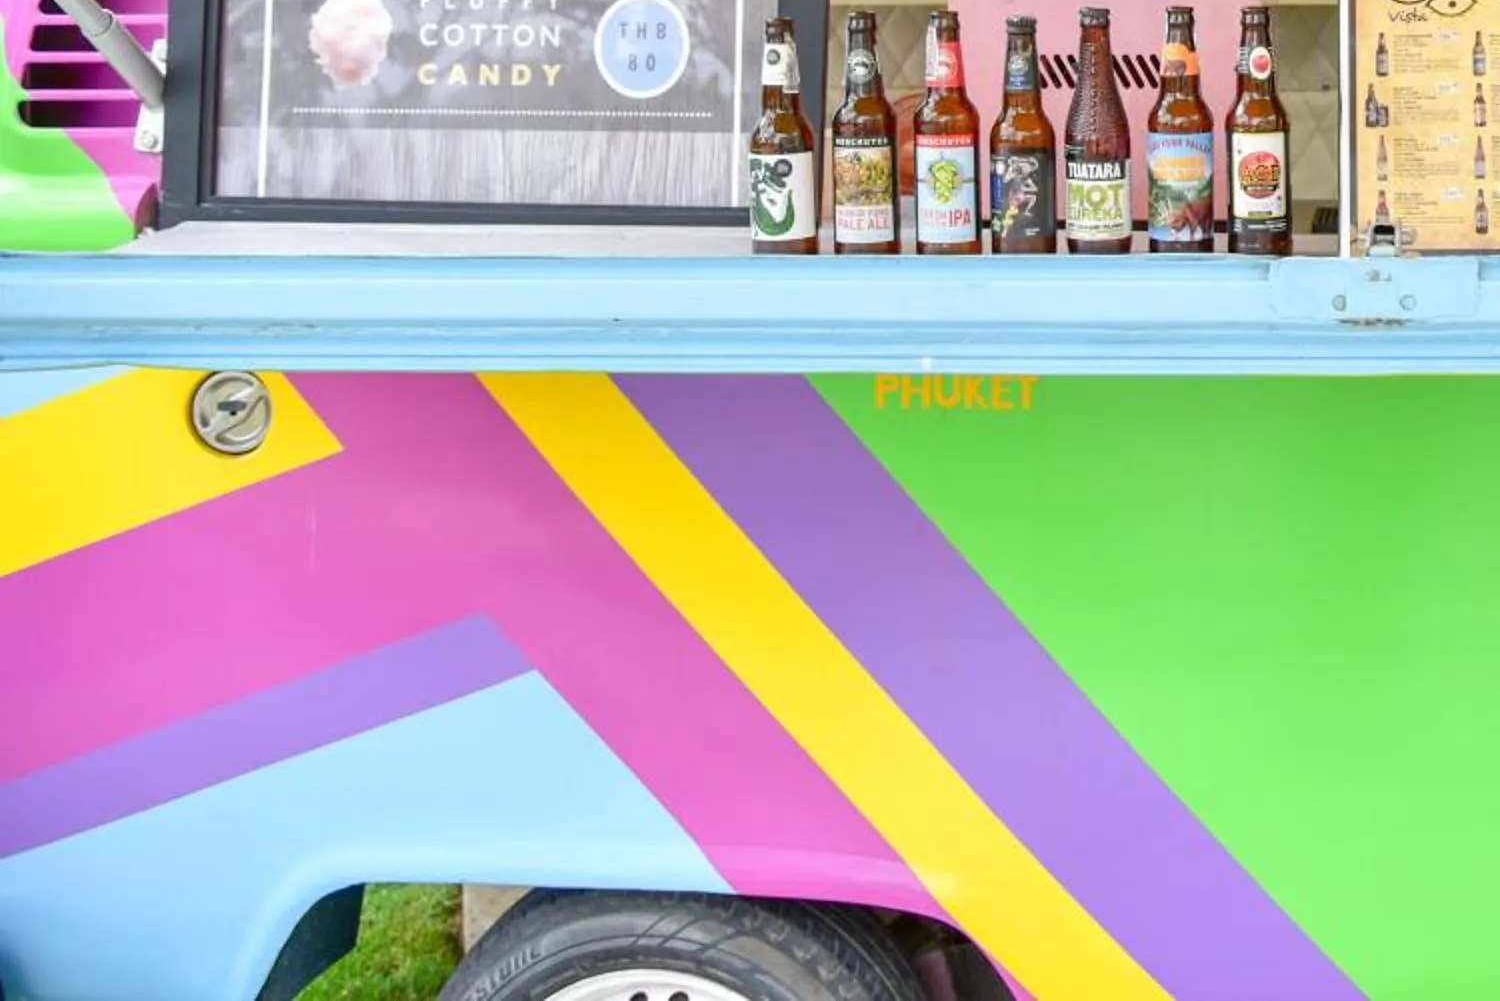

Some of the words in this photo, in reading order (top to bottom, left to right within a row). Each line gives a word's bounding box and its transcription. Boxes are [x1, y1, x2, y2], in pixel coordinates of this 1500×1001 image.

[419, 24, 560, 46] COTTON
[618, 22, 666, 39] THB
[628, 54, 656, 72] 80
[418, 64, 560, 86] CANDY
[1068, 162, 1121, 179] TUATARA
[949, 208, 970, 227] IPA
[876, 373, 1040, 408] PHUKET
